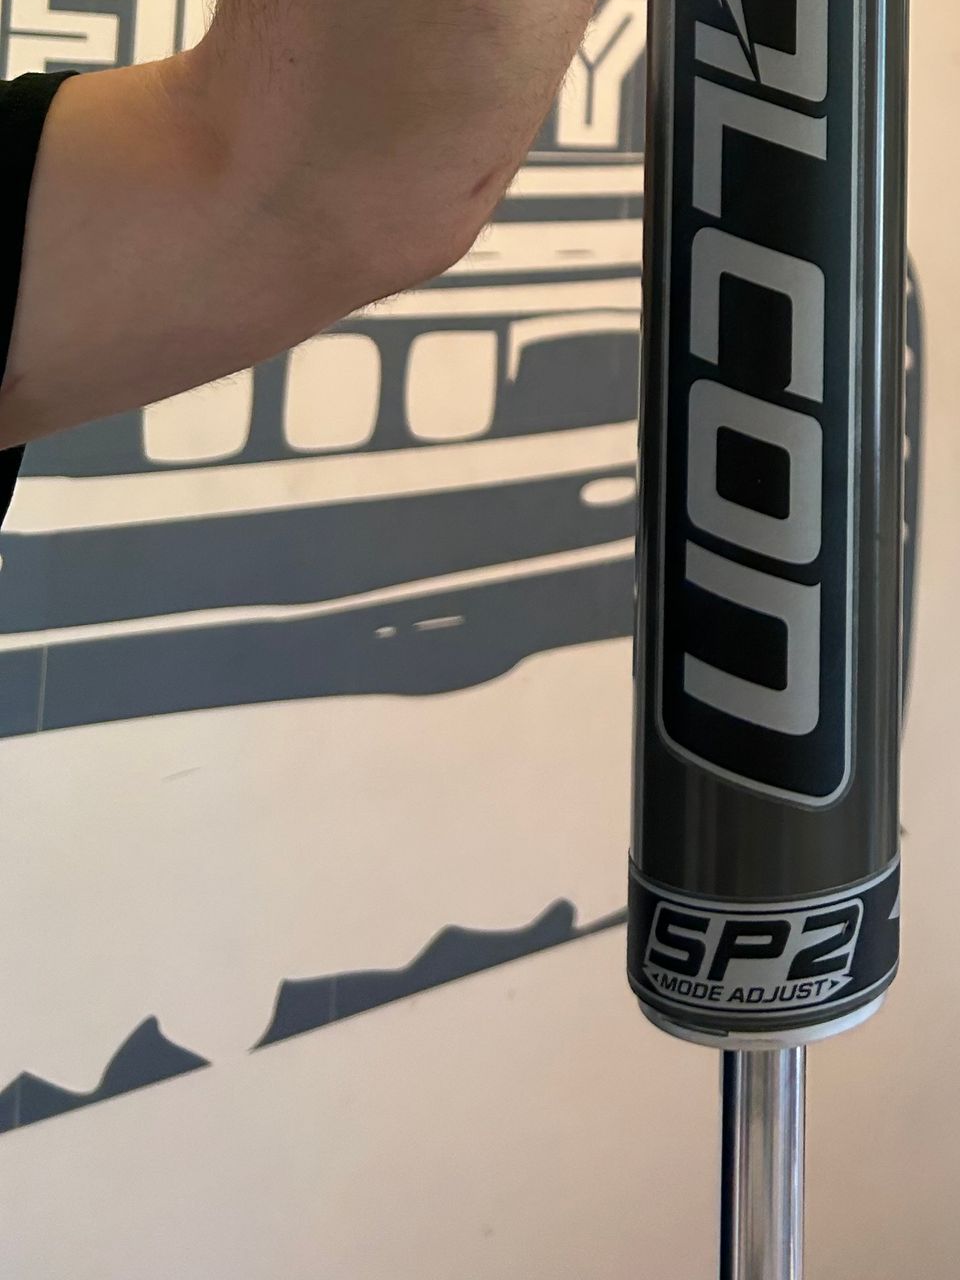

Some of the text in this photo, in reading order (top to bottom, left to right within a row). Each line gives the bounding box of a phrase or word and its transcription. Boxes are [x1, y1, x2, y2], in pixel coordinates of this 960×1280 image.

[648, 904, 861, 982] SP2
[660, 974, 829, 1004] MODE ADJUST
